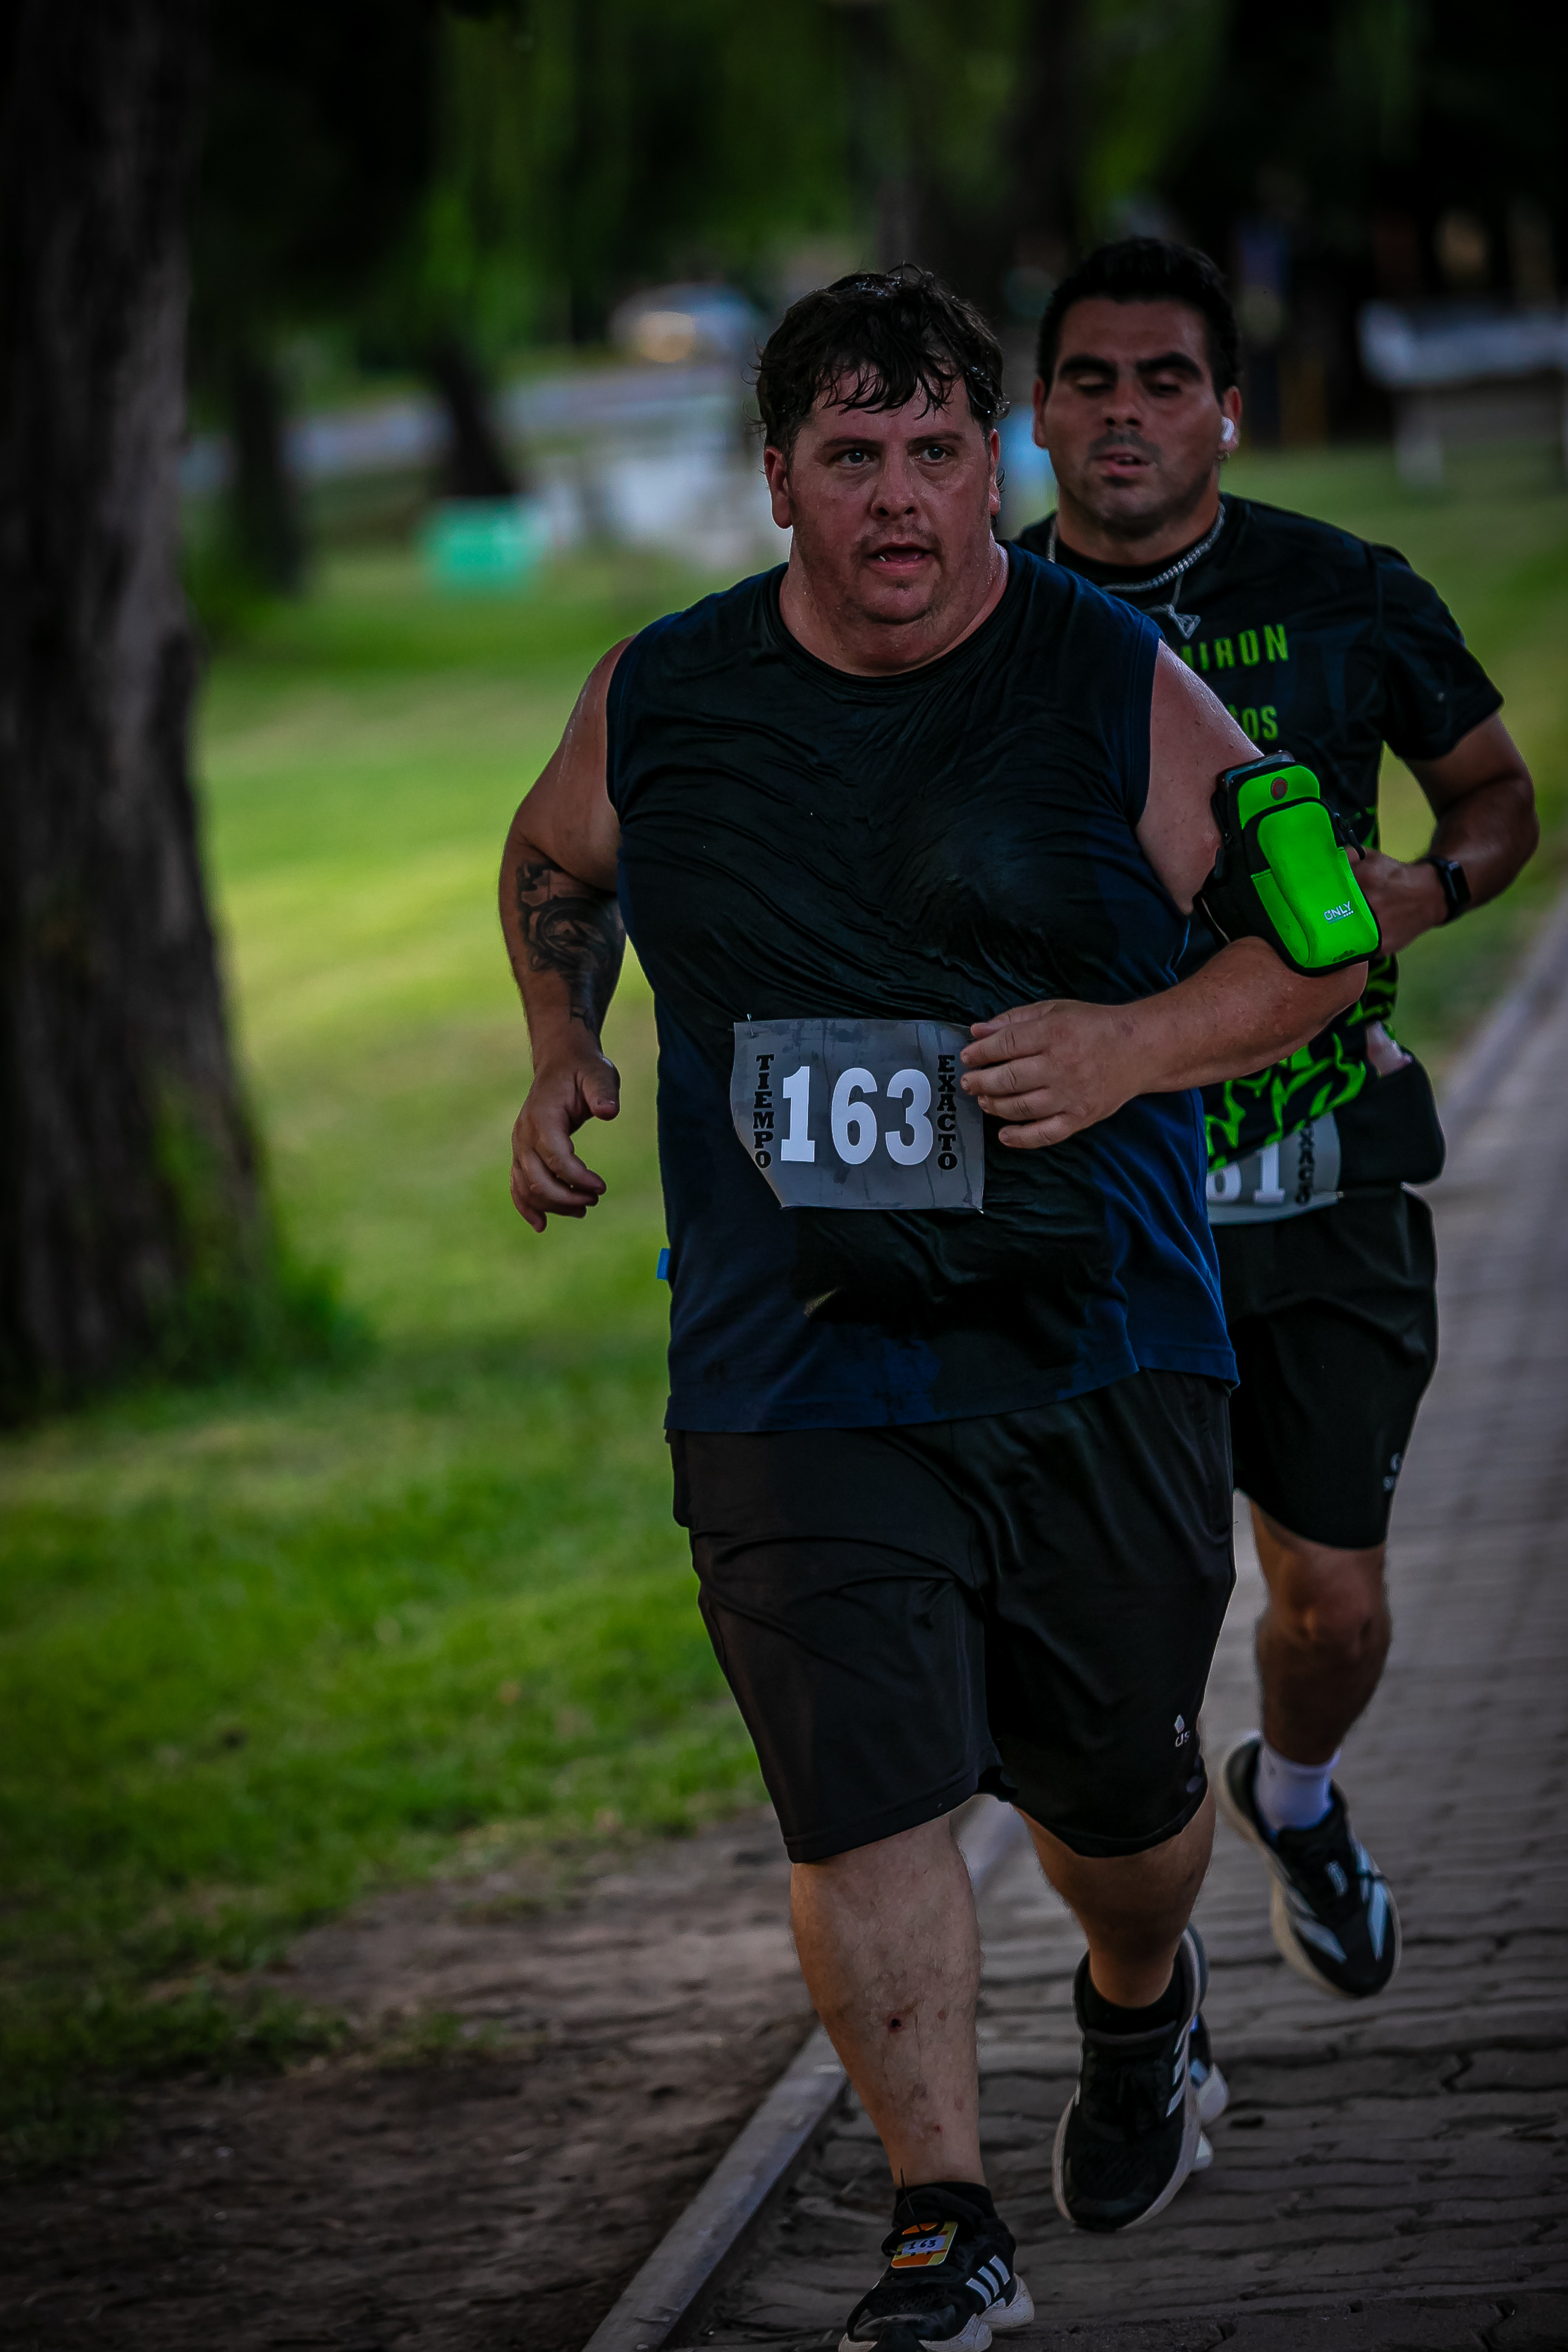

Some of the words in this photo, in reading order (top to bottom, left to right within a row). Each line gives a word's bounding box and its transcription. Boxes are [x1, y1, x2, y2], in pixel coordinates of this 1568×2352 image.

[1227, 704, 1278, 741] OS
[1324, 900, 1351, 921] ONLY
[753, 1054, 775, 1169] TIEMPO
[780, 1065, 933, 1165] 163
[936, 1054, 958, 1170] EXACTO
[908, 2239, 938, 2250] 163
